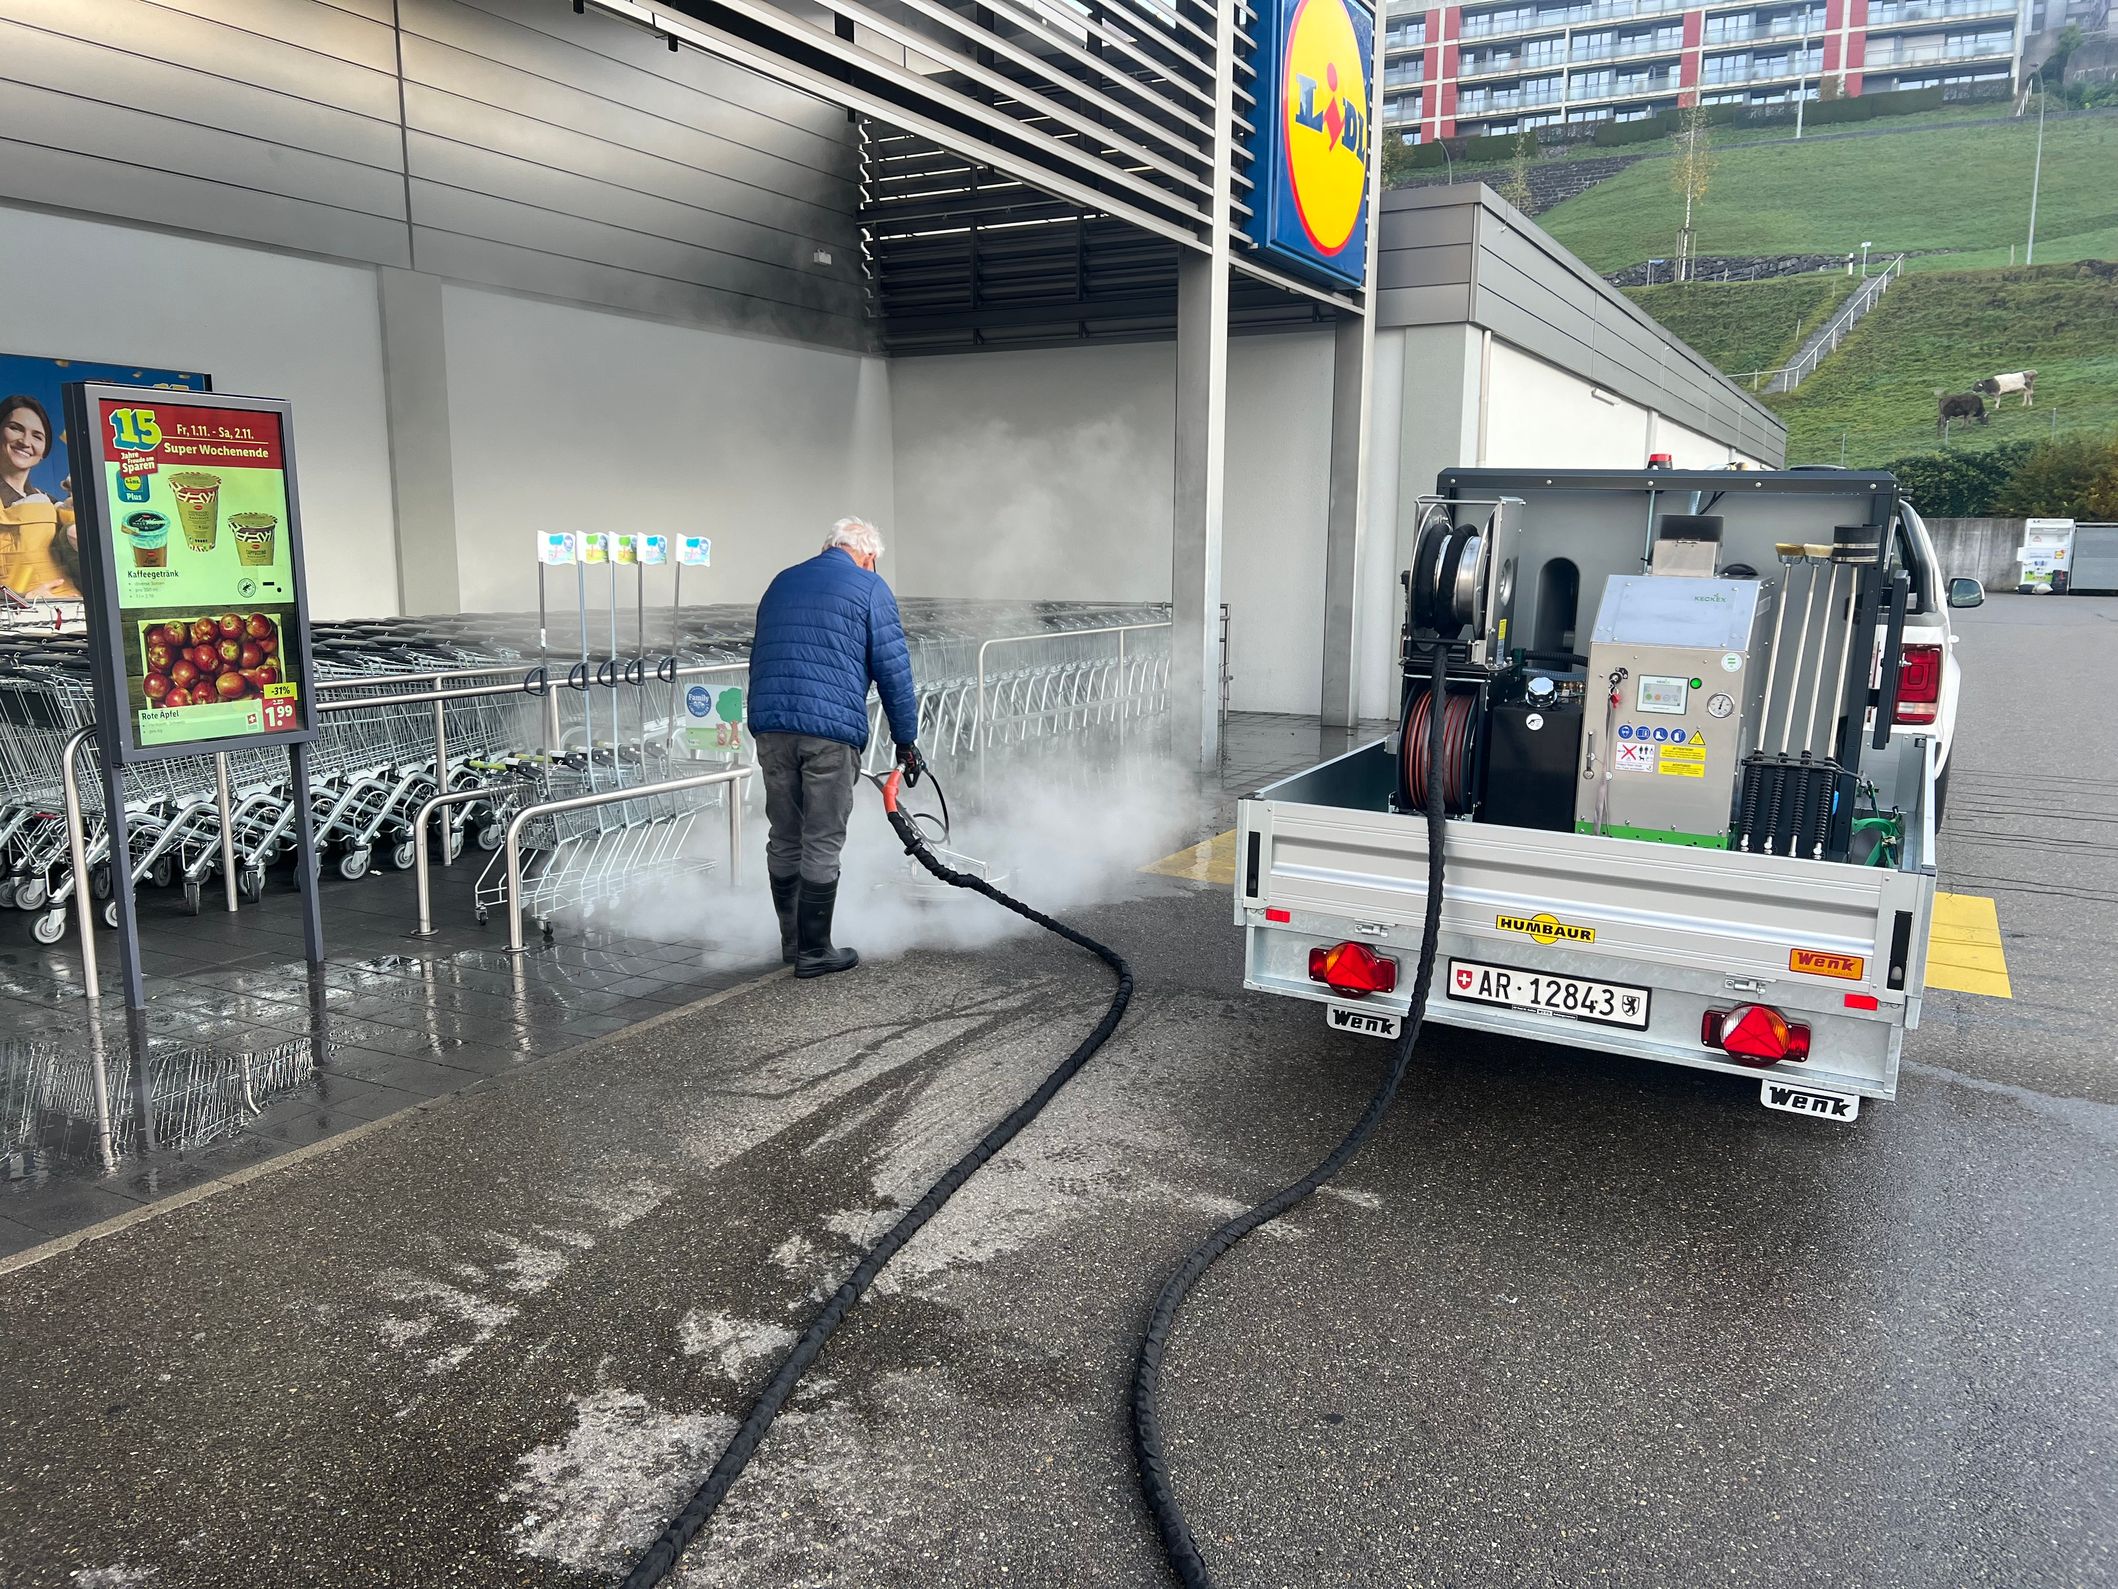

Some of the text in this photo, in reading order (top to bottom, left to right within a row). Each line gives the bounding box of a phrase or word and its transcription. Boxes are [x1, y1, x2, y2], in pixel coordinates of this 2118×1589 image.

[109, 408, 163, 451] 15
[176, 424, 190, 437] Fr,
[191, 425, 210, 437] 1.11.
[218, 427, 233, 439] Sa,
[235, 428, 254, 439] 2.11.
[120, 451, 139, 460] Jahre
[164, 442, 269, 458] Super Wochenende
[122, 461, 155, 474] Sparen
[126, 492, 142, 500] Plus
[127, 569, 179, 580] Kaffeegetränk
[271, 686, 291, 696] -31%
[688, 693, 710, 704] Family
[141, 712, 159, 721] Rote
[1500, 918, 1592, 941] HUMBAUR
[1797, 951, 1855, 972] Wenk
[1478, 970, 1511, 1000] AR
[1529, 977, 1616, 1017] 12843
[1332, 1008, 1395, 1036] Wenk
[1768, 1085, 1852, 1117] Wenk
